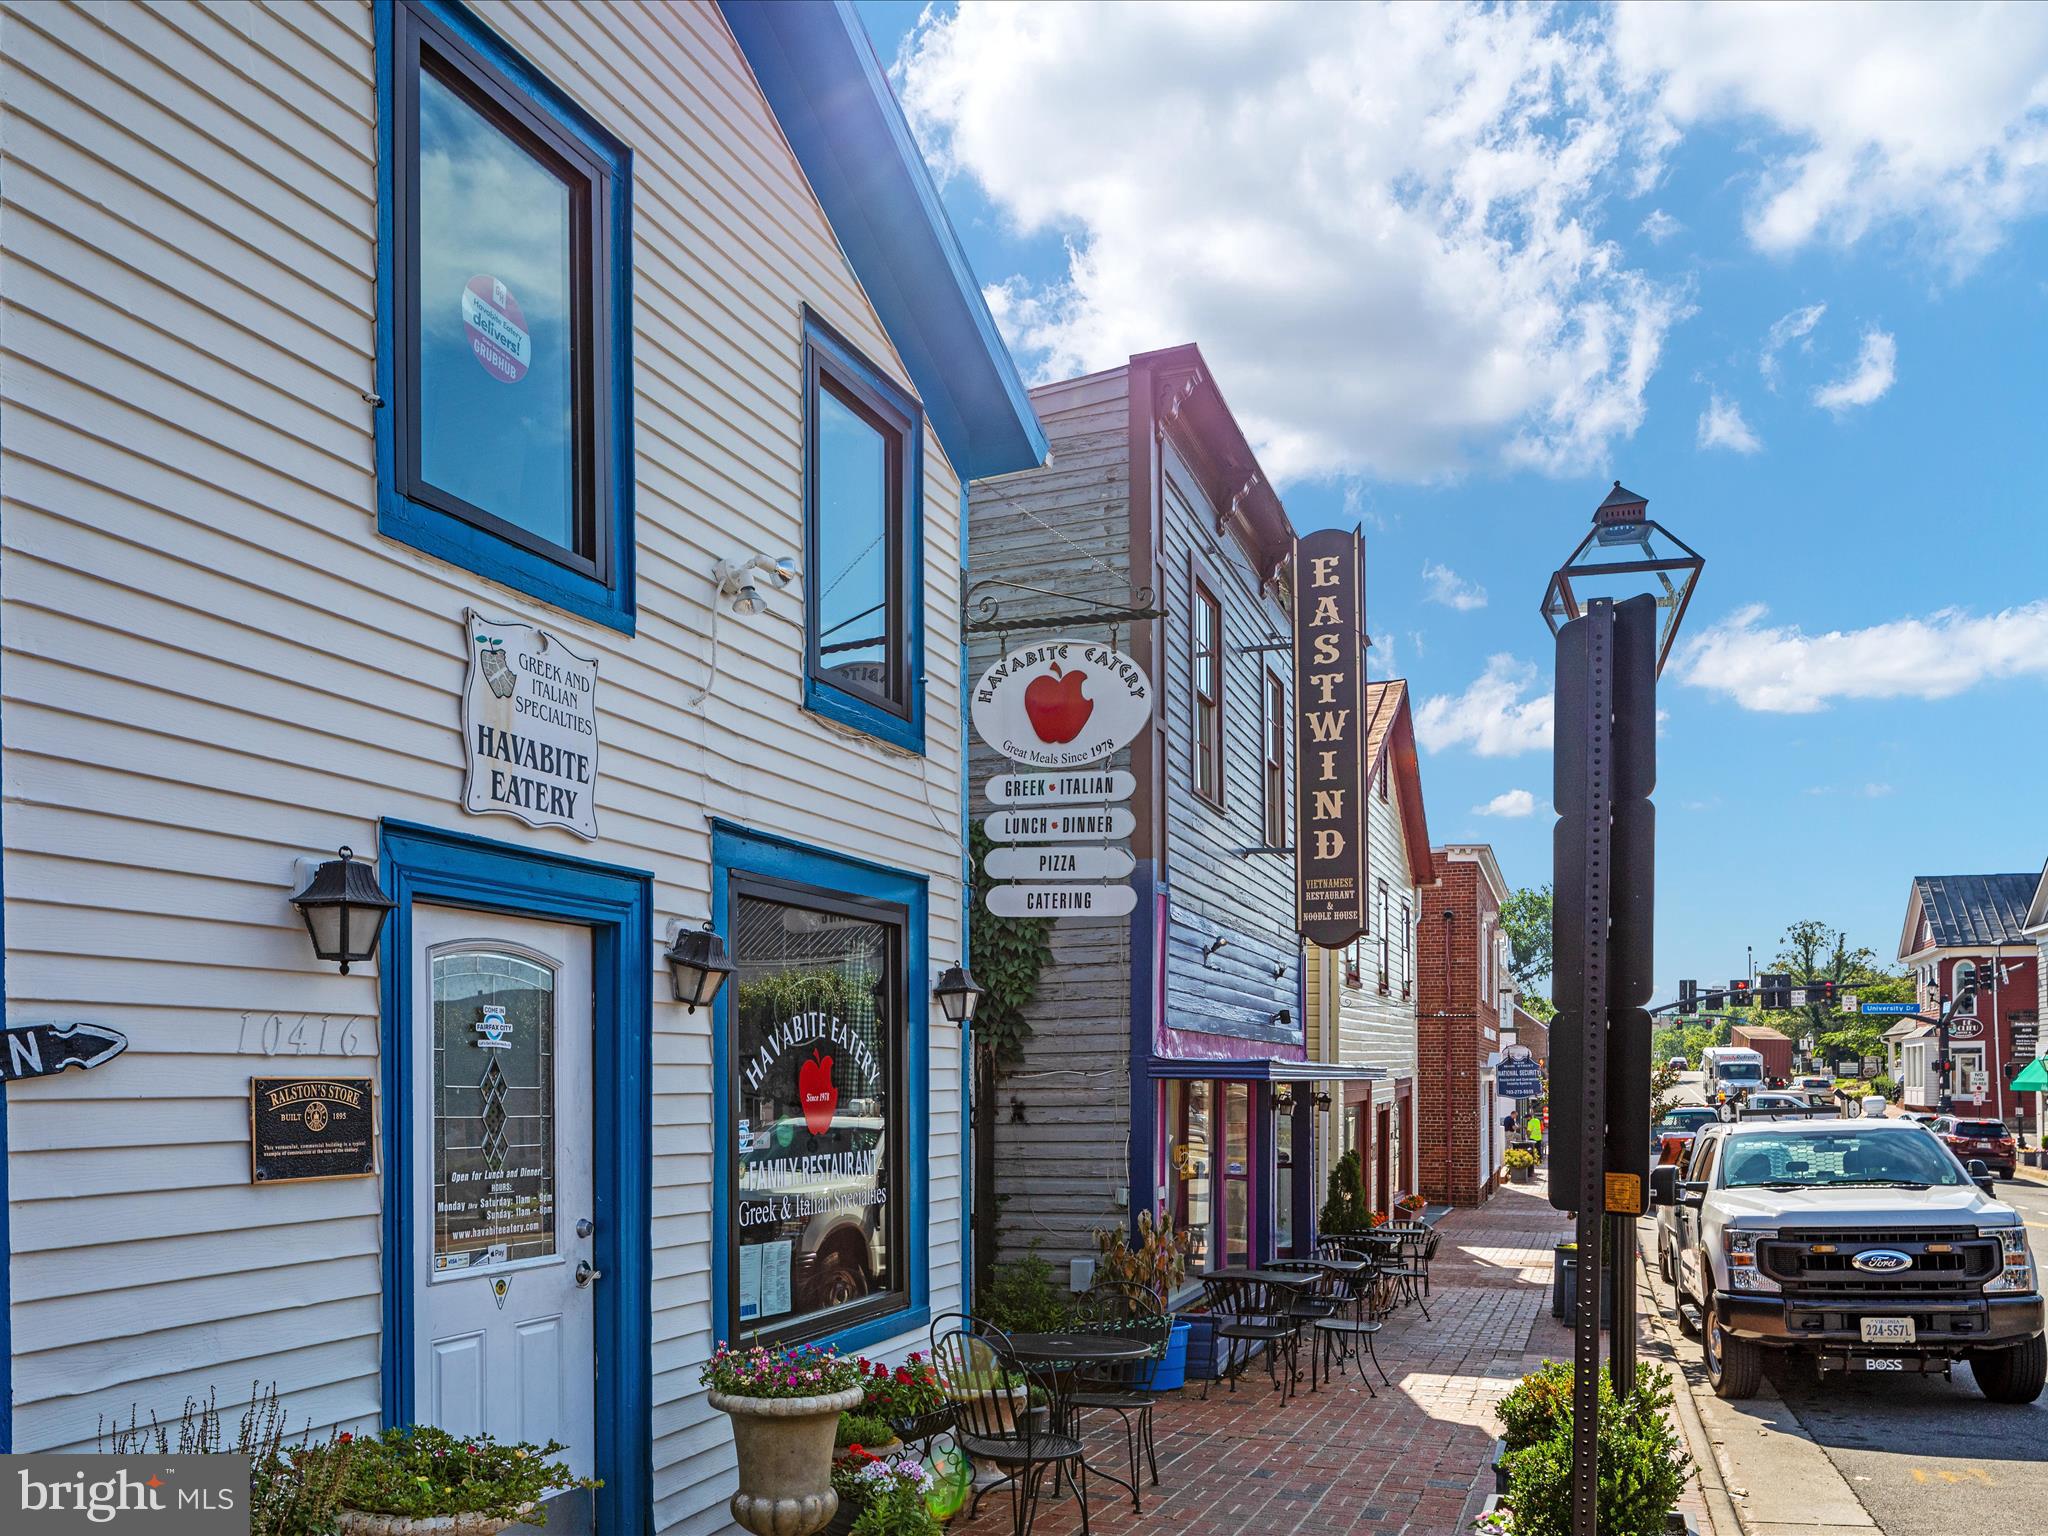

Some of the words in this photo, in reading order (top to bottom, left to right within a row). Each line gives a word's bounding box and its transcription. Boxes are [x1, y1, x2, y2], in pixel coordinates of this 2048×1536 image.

[473, 297, 502, 325] Havabite
[502, 321, 523, 342] Eatery
[472, 313, 521, 357] delivers!
[473, 338, 517, 380] GRUBHUB
[518, 653, 562, 683] GREEK
[564, 671, 590, 693] AND
[977, 643, 1070, 704] HAVABITE
[1083, 647, 1146, 700] EATERY
[531, 678, 578, 710] ITALIAN
[515, 695, 593, 736] SPECIALTIES
[1304, 555, 1351, 860] EASTWIND
[477, 723, 590, 785] HAVABITE
[1002, 739, 1028, 760] Great
[1029, 750, 1059, 765] Meals
[1061, 750, 1089, 765] Since
[1089, 738, 1115, 758] 1978
[490, 769, 578, 819] EATERY
[1005, 779, 1045, 797] GREEK
[1060, 776, 1113, 796] ITALIAN
[1005, 817, 1047, 835] LUNCH
[1062, 816, 1113, 834] DINNER
[1039, 855, 1076, 872] PIZZA
[1305, 877, 1354, 890] VIETNAMESE
[1027, 892, 1092, 910] CATERING
[1305, 889, 1355, 901] RESTAURANT
[1326, 901, 1334, 910] &
[1303, 911, 1332, 921] NOODLE
[1334, 910, 1358, 920] HOUSE
[237, 1010, 360, 1056] 10416
[476, 1023, 499, 1031] FAIRFAX
[0, 1030, 44, 1077] N
[745, 1012, 828, 1091] HAVABITE
[830, 1016, 881, 1086] EATERY
[270, 1084, 327, 1107] RALSTON'S
[328, 1085, 360, 1106] STORE
[806, 1092, 819, 1103] Since
[280, 1113, 302, 1122] BUILT
[332, 1112, 347, 1120] 1895
[451, 1171, 469, 1182] Open
[471, 1170, 482, 1180] for
[484, 1169, 504, 1180] Lunch
[506, 1168, 518, 1178] and
[520, 1166, 543, 1177] Dinner!
[749, 1157, 799, 1191] FAMILY
[802, 1149, 878, 1185] RESTAURANT
[491, 1183, 512, 1192] HOURS:
[437, 1201, 466, 1212] Monday
[467, 1202, 478, 1210] thru
[480, 1195, 513, 1208] Saturday:
[515, 1194, 531, 1205] 11am
[739, 1198, 777, 1227] Greek
[780, 1195, 792, 1219] &
[796, 1192, 831, 1218] Italian
[834, 1186, 887, 1216] Specialties
[486, 1208, 514, 1221] Sunday:
[515, 1207, 531, 1217] 11am
[452, 1222, 539, 1240] www.havabiteeatery.com
[494, 1249, 505, 1257] Pay
[1868, 1256, 1897, 1267] Ford
[1865, 1324, 1912, 1336] 224-557L
[1866, 1358, 1903, 1371] BOSS
